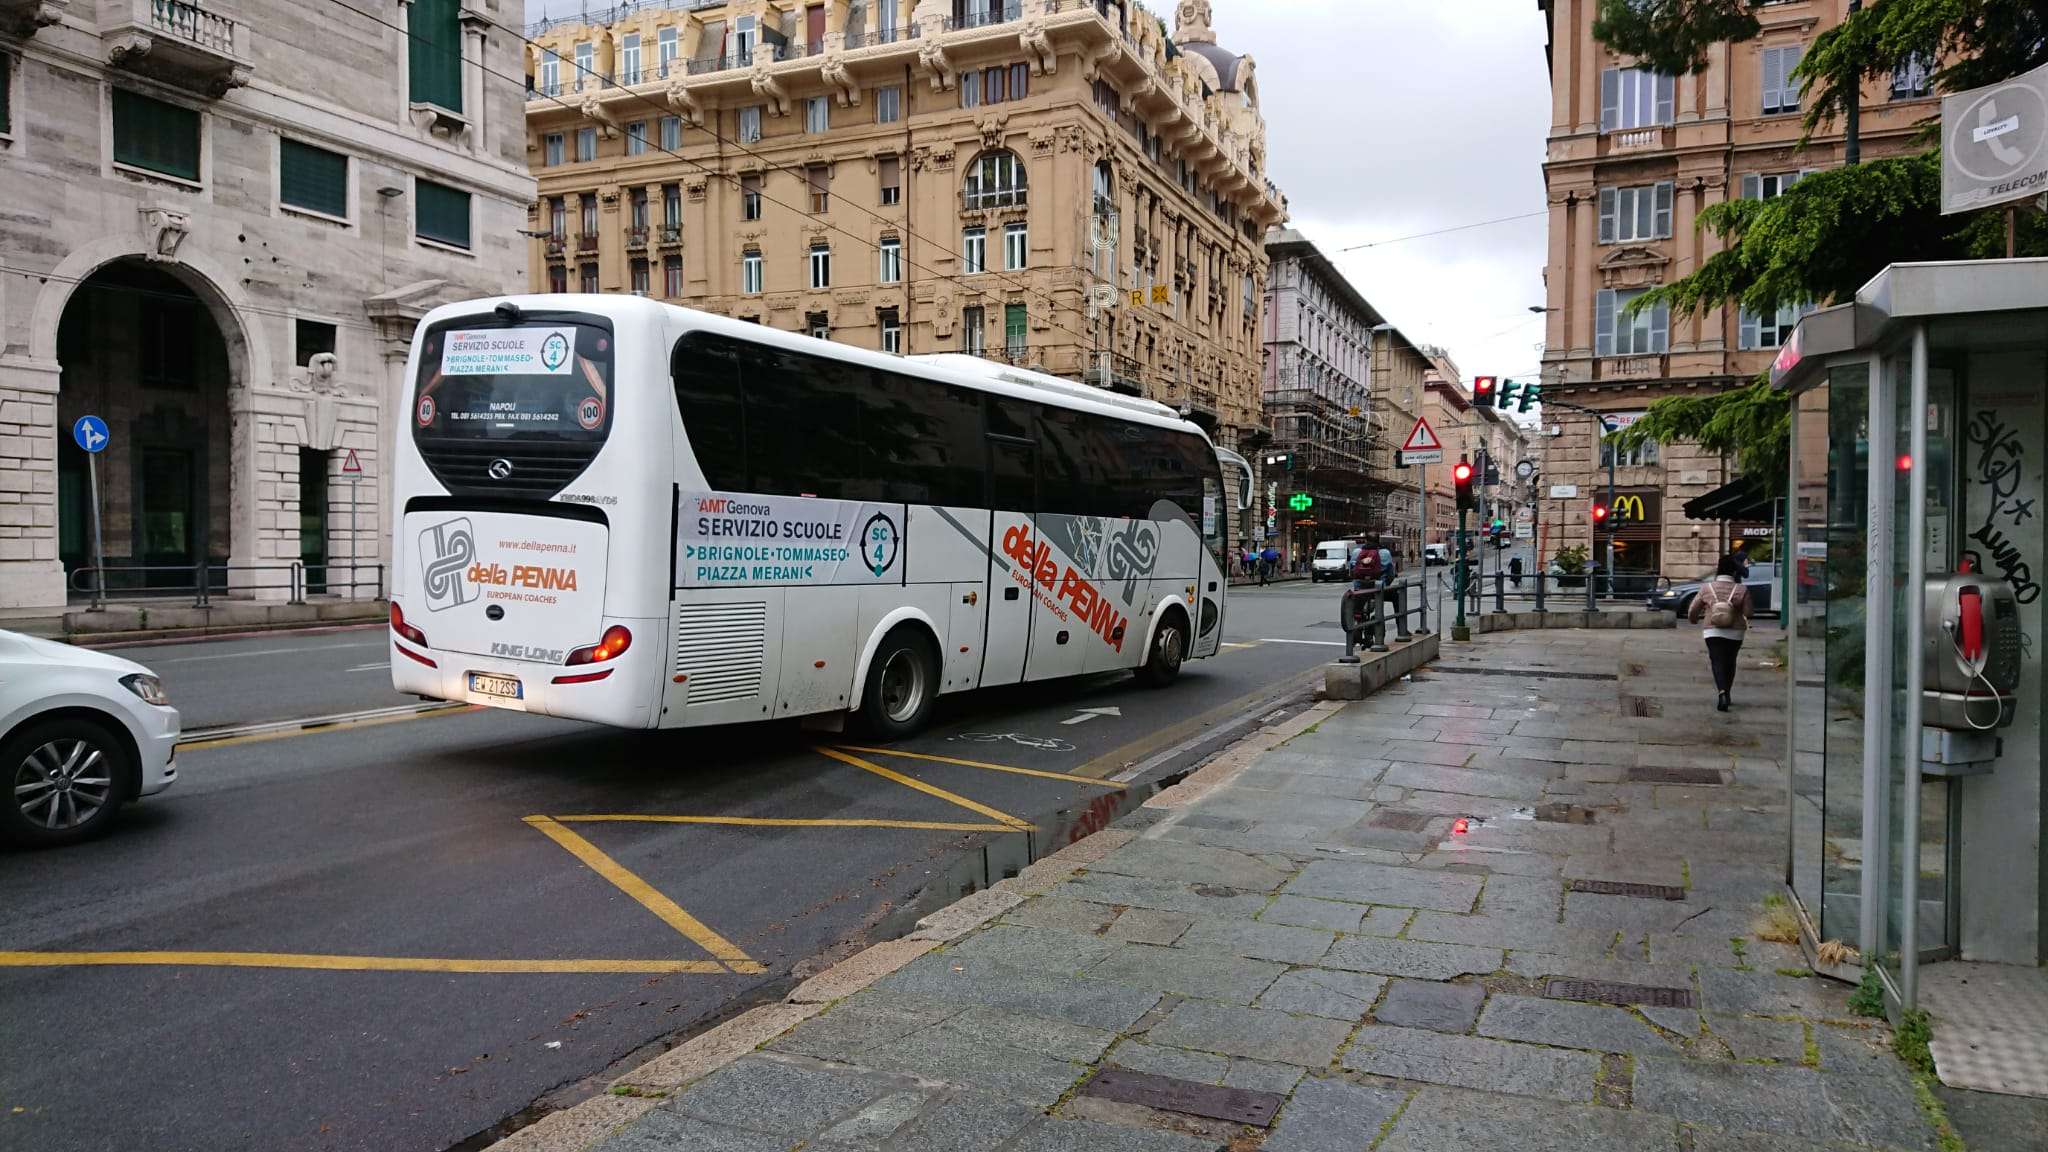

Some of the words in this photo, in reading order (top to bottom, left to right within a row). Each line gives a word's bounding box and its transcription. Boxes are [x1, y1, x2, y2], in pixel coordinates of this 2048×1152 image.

[1990, 169, 2048, 195] TELECOM
[452, 341, 490, 351] SERVIZIO
[491, 340, 525, 350] SCUOLE
[549, 341, 561, 350] SC
[549, 351, 558, 362] 4
[449, 365, 474, 373] PIAZZA
[489, 402, 516, 411] NAPOLI
[582, 405, 598, 418] 100
[697, 517, 778, 538] SERVIZIO
[783, 523, 842, 540] SCUOLE
[871, 528, 888, 541] SC
[499, 539, 577, 553] www.dellapenna.it
[873, 544, 884, 561] 4
[467, 562, 507, 585] della
[511, 565, 577, 592] PENNA
[697, 566, 748, 580] PIAZZA
[1002, 523, 1058, 592] della
[1057, 566, 1128, 653] PENNA
[487, 590, 522, 601] EUROPEAN
[524, 593, 557, 604] COACHES
[1043, 596, 1068, 622] COACHES
[490, 642, 524, 657] KING
[524, 646, 563, 662] LONG
